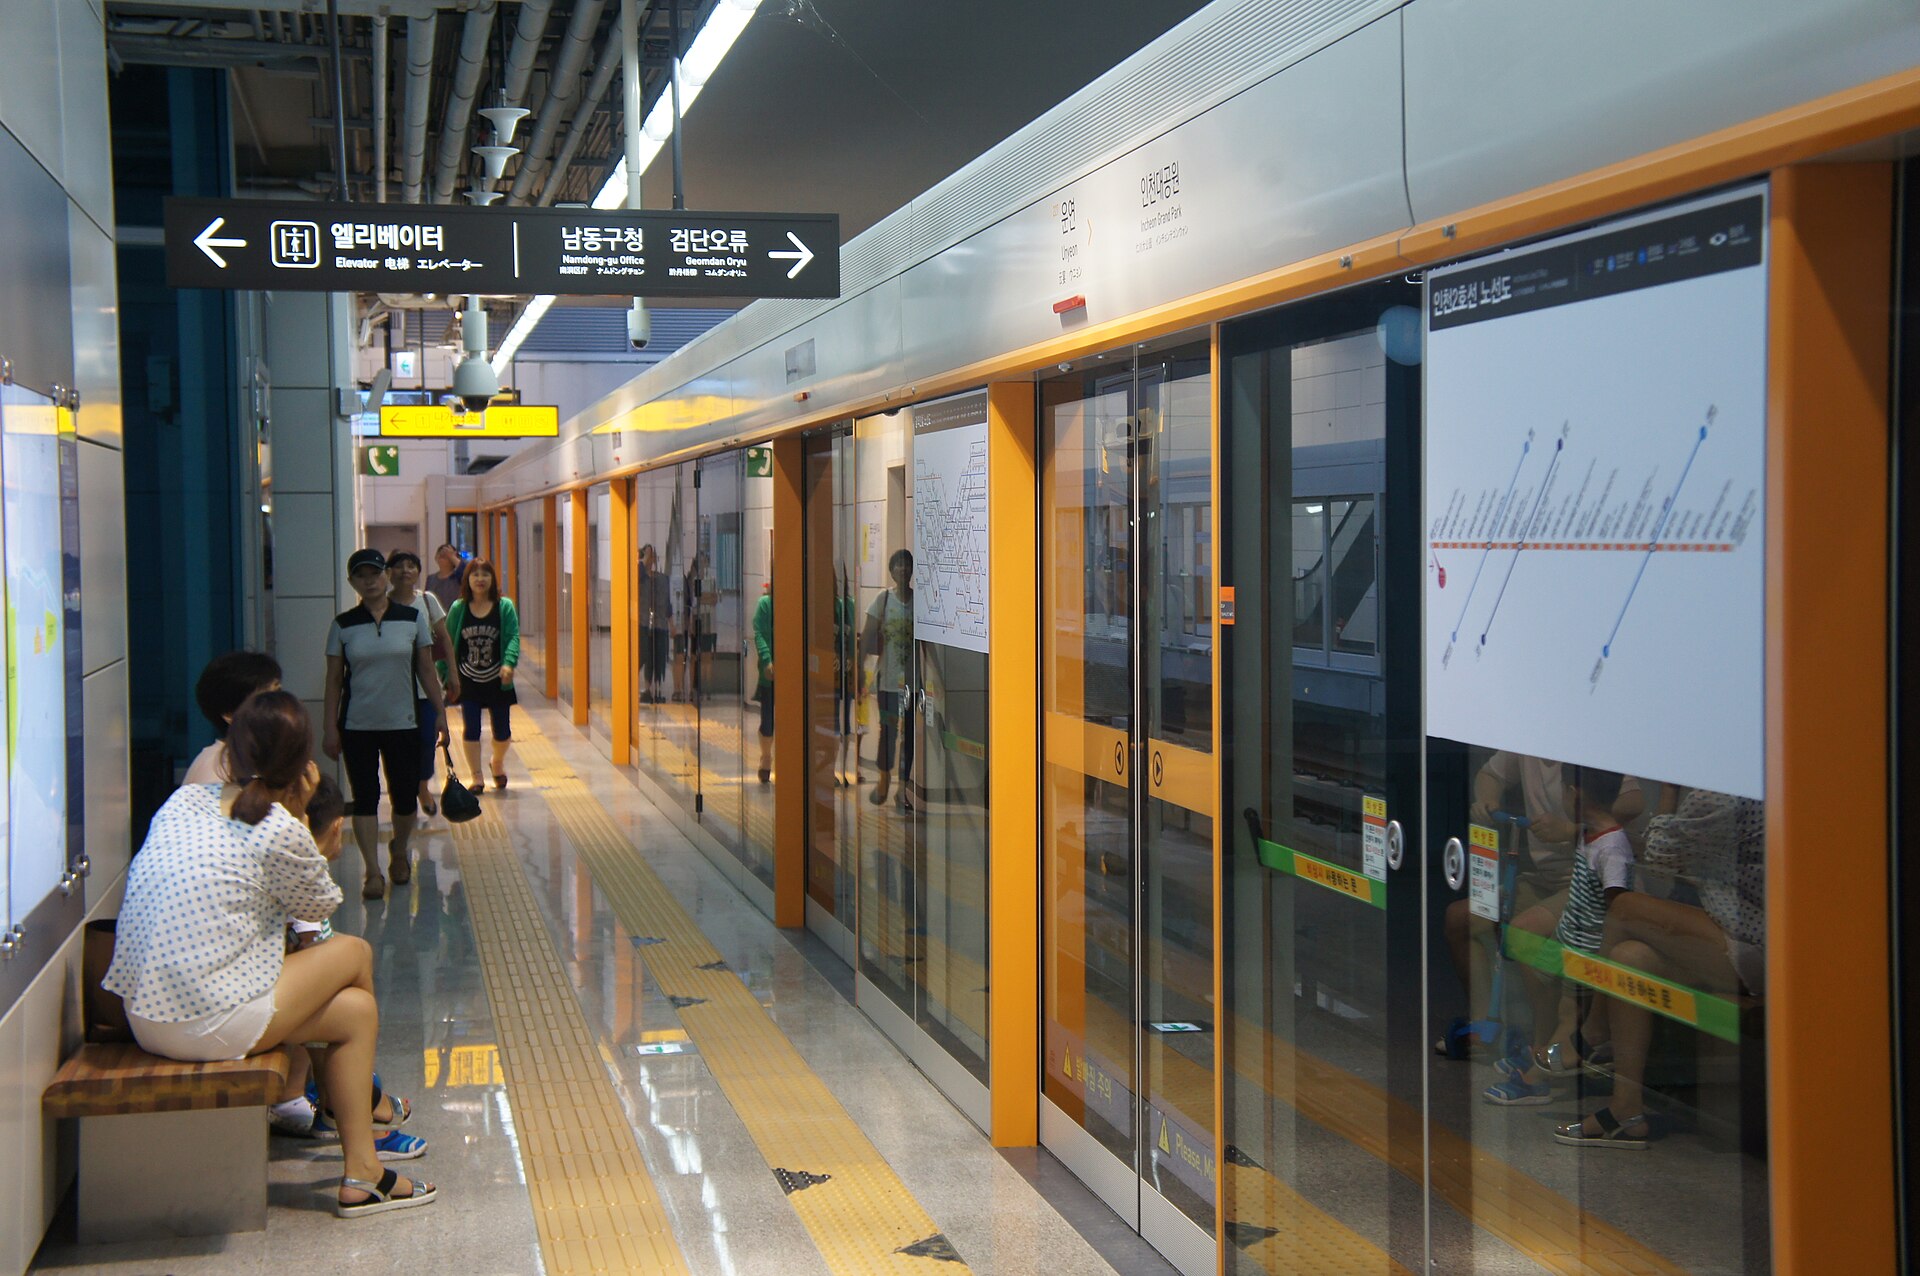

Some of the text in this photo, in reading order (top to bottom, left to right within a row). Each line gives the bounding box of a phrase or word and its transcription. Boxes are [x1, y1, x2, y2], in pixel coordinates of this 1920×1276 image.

[1140, 159, 1180, 208] 인천대공원
[1061, 197, 1076, 235] 운연
[1140, 204, 1183, 233] Incheon Grand Park
[330, 222, 444, 252] 엘리베이터
[561, 226, 644, 253] 남동구청
[669, 228, 749, 254] 검단오류
[335, 256, 380, 269] Elevator
[416, 259, 484, 271] エレベーター
[562, 254, 645, 266] Namdong-gu Office
[685, 256, 747, 268] Geomdan Oryu
[1061, 244, 1078, 263] Unyeon
[1433, 281, 1478, 317] 인천2호선
[1479, 275, 1513, 305] 노선도
[1075, 1055, 1096, 1093] 발빠짐
[1096, 1070, 1113, 1105] 주의
[1175, 1132, 1203, 1177] Please,
